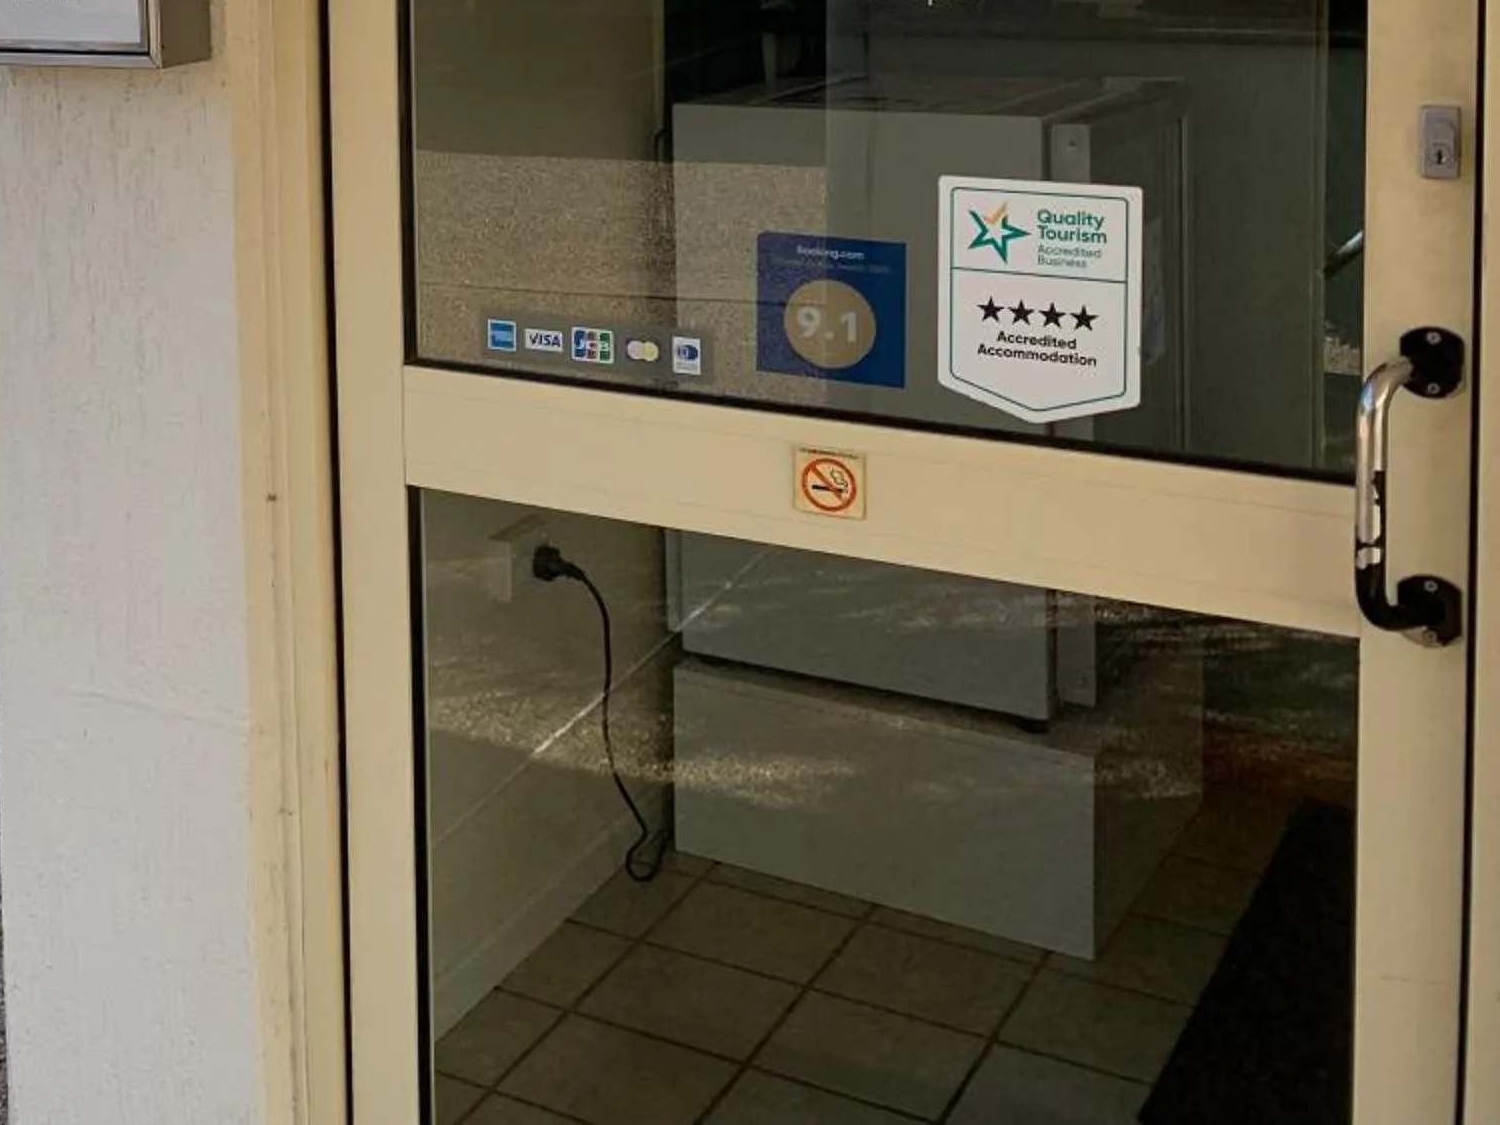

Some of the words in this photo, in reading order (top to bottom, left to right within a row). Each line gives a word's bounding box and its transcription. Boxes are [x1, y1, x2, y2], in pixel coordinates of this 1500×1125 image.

[1036, 208, 1106, 230] Quality
[1037, 225, 1108, 245] Tourism
[1037, 244, 1102, 260] Accredited
[1037, 255, 1088, 268] Business
[796, 305, 860, 344] 9.1
[528, 332, 561, 348] VISA
[996, 331, 1078, 350] Accredited
[976, 343, 1098, 367] Accommodation
